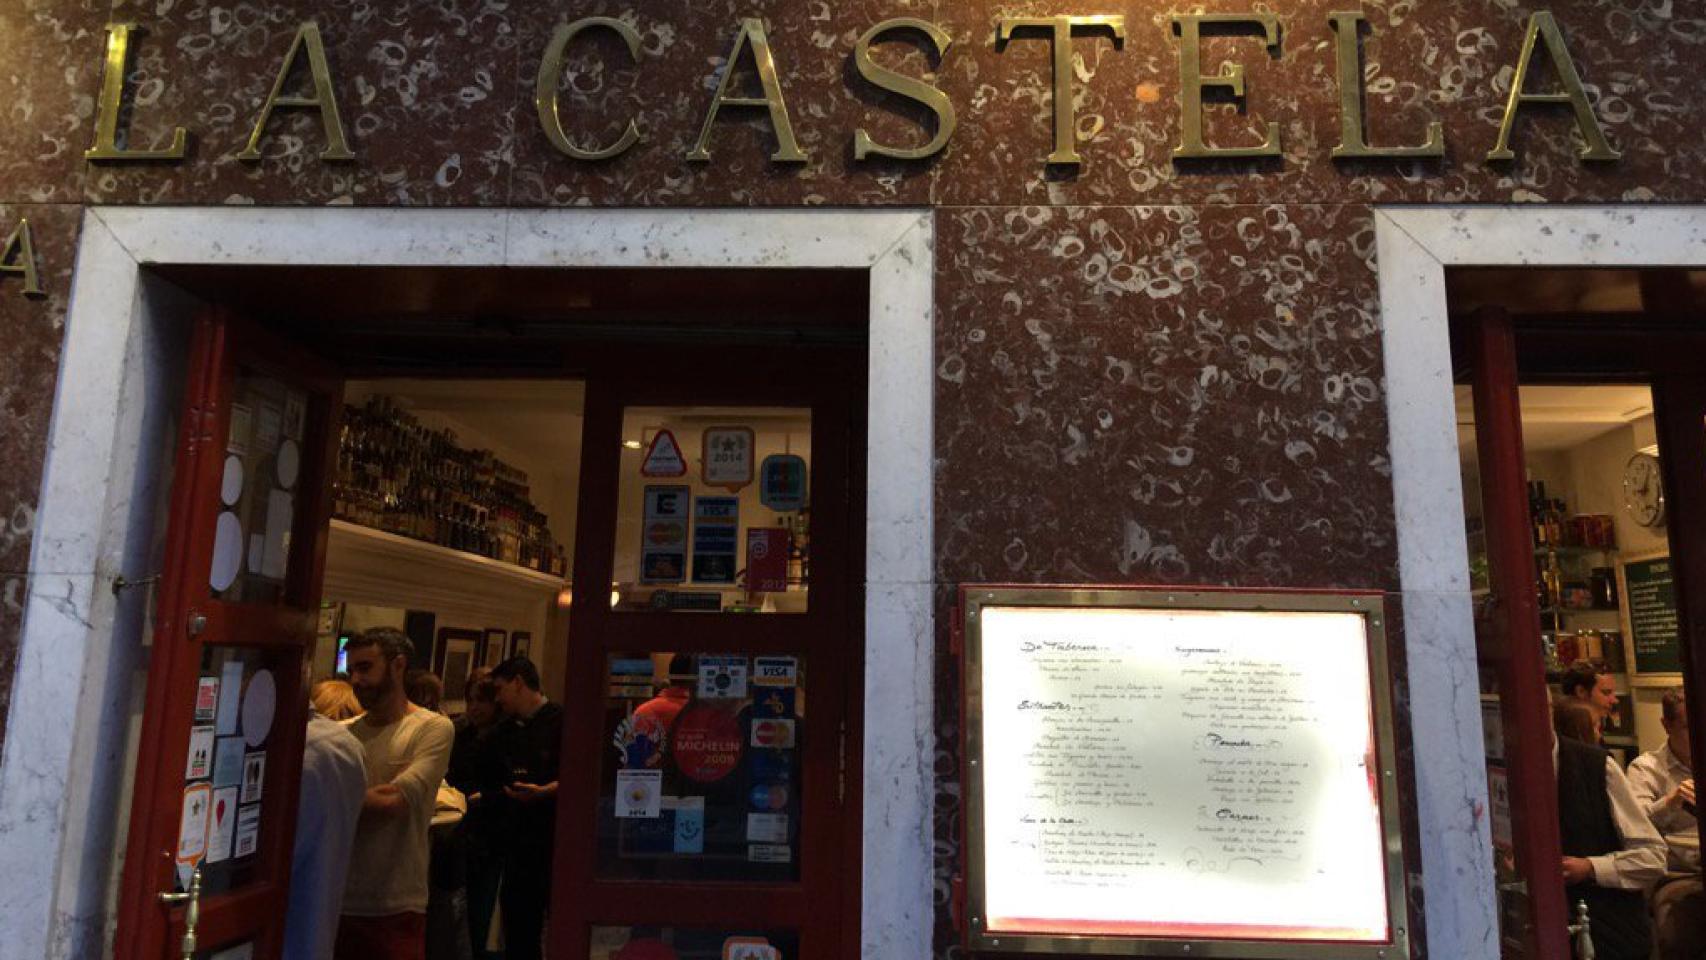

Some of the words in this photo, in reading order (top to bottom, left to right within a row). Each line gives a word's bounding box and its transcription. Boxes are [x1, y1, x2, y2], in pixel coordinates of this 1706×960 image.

[85, 22, 356, 161] LA
[536, 10, 1622, 166] CASTELA
[714, 453, 743, 462] 2014
[763, 667, 788, 676] VISA
[676, 741, 740, 751] MICHELIN
